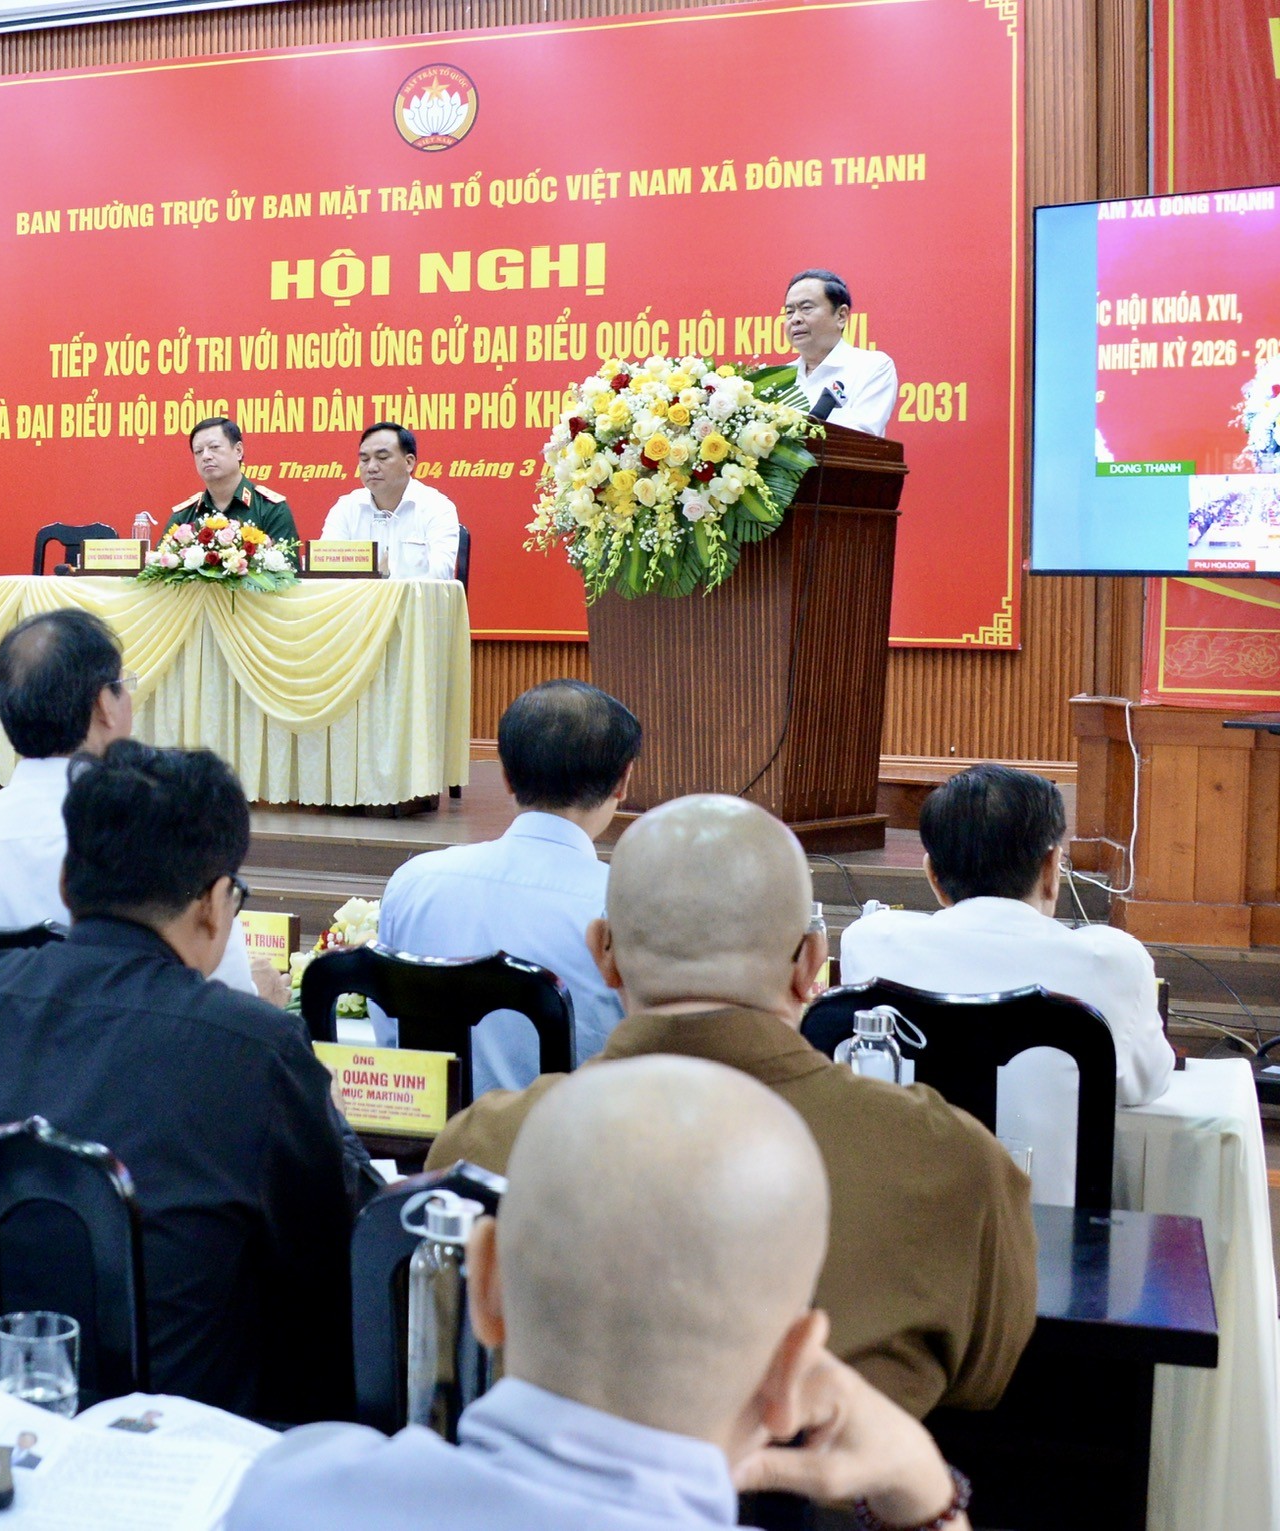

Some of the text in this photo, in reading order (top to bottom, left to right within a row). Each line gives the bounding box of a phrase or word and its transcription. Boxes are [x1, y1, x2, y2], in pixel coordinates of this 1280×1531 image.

[16, 153, 926, 235] BAN THƯỜNG TRỰC ỦY BAN MẶT TRẬN TỔ QUỐC VIỆT NAM XÃ ĐÔNG THẠNH
[1214, 191, 1275, 215] THẠNH
[270, 242, 606, 307] HỘI NGHỊ
[1116, 293, 1148, 330] HỘI
[1152, 290, 1202, 324] KHÓA
[1206, 293, 1243, 323] XVI,
[49, 332, 97, 378] TIẾP
[104, 332, 150, 376] XÚC
[157, 326, 192, 374] CỬ
[196, 338, 231, 372] TRI
[239, 326, 278, 371] VỚI
[286, 322, 362, 369] NGƯỜI
[370, 323, 422, 367] ỨNG
[431, 315, 469, 365] CỬ
[473, 326, 517, 372] ĐẠI
[526, 307, 587, 362] BIỂU
[596, 306, 670, 361] QUỐC
[735, 305, 799, 355] KHÓ
[1098, 338, 1158, 375] NHIỆM
[1162, 336, 1187, 368] KỲ
[1191, 339, 1237, 366] 2026
[16, 404, 53, 446] ĐẠI
[60, 389, 112, 438] BIỂU
[118, 393, 157, 444] HỘI
[236, 390, 305, 434] NHÂN
[313, 388, 363, 432] DÂN
[371, 386, 455, 430] THÀNH
[464, 378, 518, 429] PHỐ
[898, 382, 968, 422] 2031
[279, 461, 347, 483] Thạnh,
[415, 461, 443, 479] 04
[448, 459, 514, 479] tháng
[519, 459, 536, 476] 3
[1109, 462, 1182, 474] DONG THANH
[255, 934, 286, 949] TRUNG
[352, 1054, 375, 1066] ÔNG
[343, 1069, 426, 1090] QUANG VINH
[341, 1087, 363, 1100] MỤC
